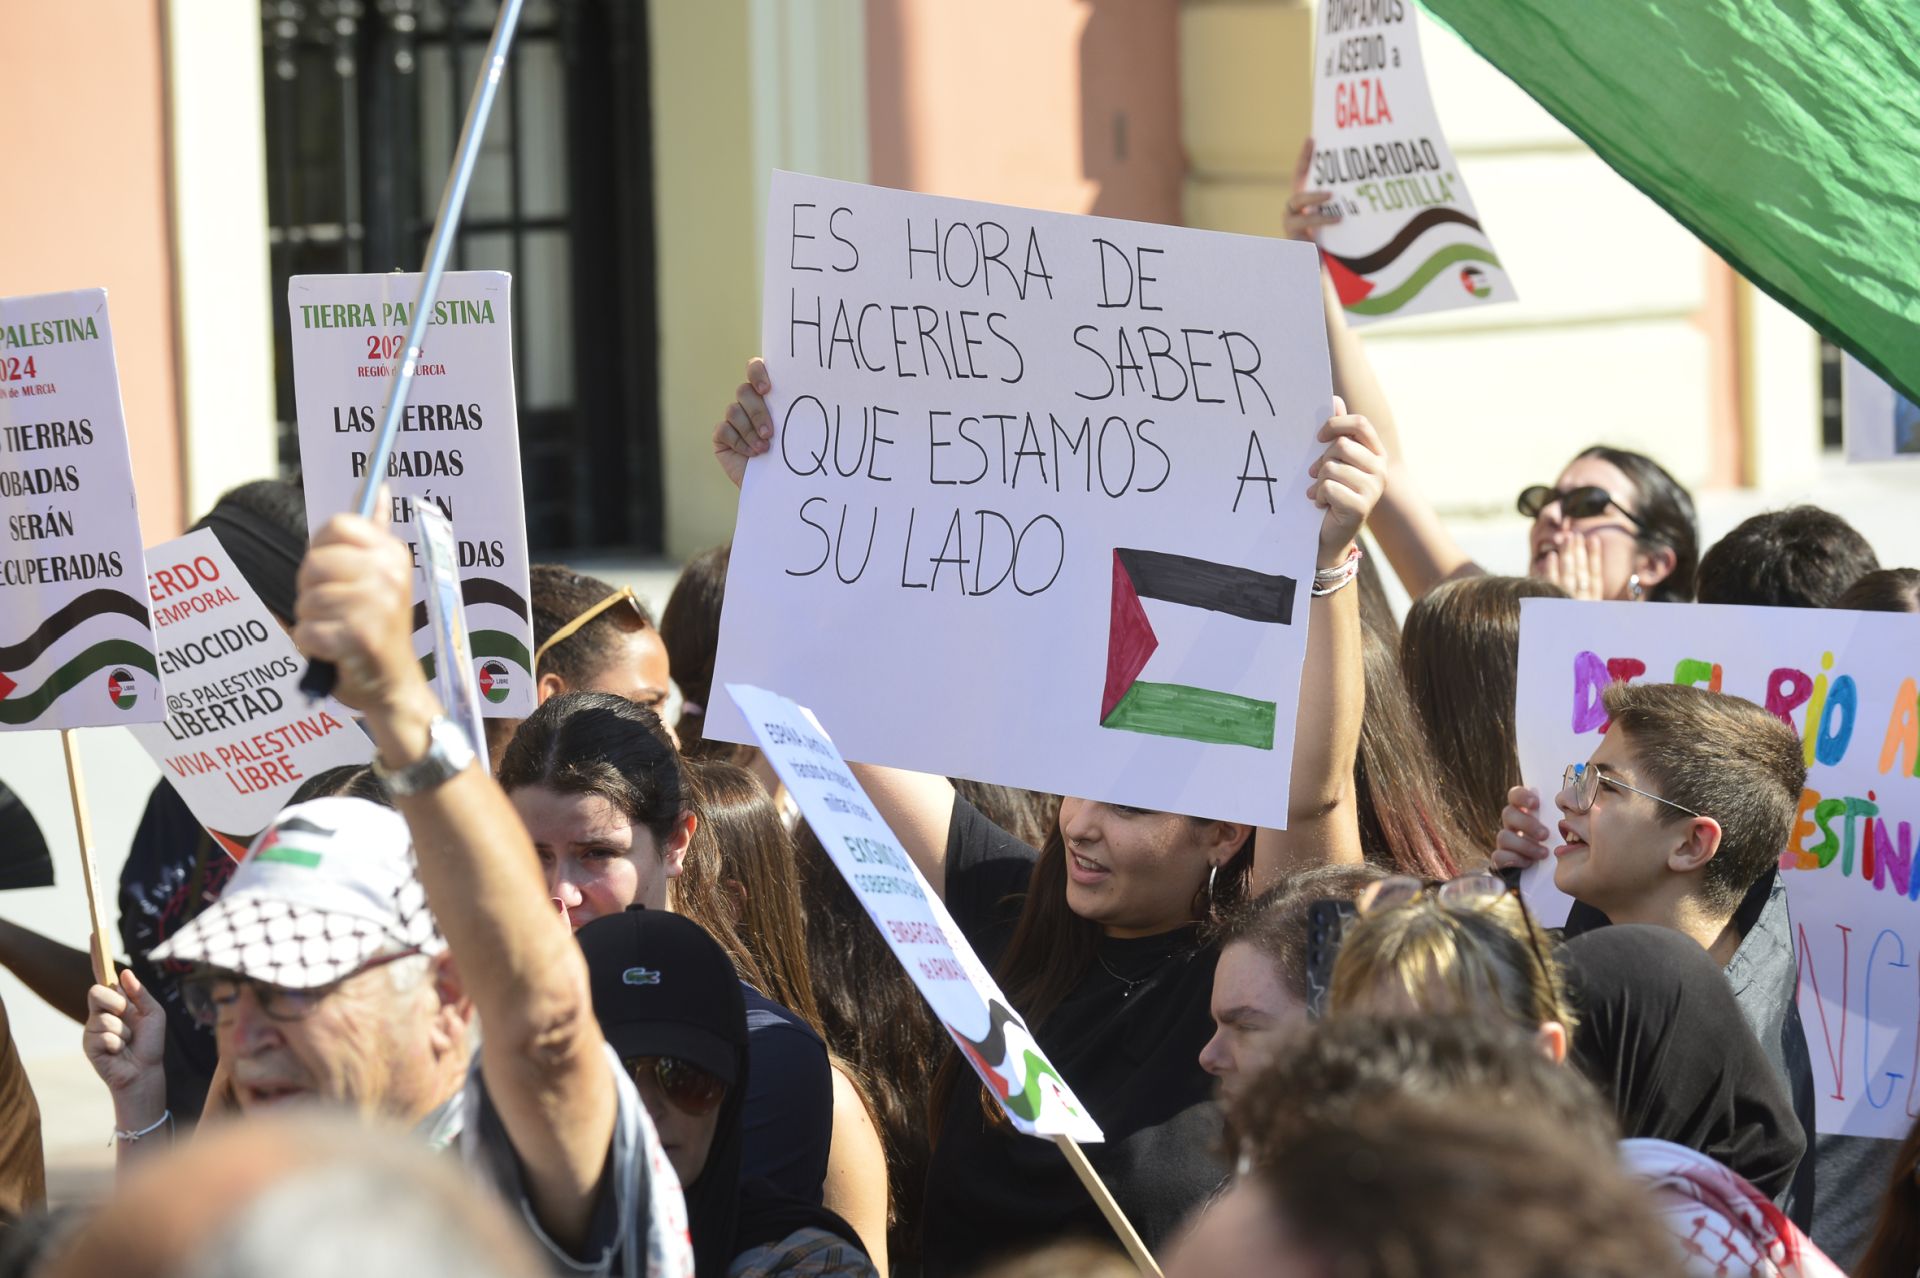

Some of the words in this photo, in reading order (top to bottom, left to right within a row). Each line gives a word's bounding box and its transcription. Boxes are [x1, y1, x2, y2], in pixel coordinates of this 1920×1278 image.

[1335, 78, 1393, 128] GAZA
[1315, 138, 1440, 185] SOLIDARIDAD
[791, 203, 859, 272] ES
[907, 218, 1054, 301] HORA
[1092, 238, 1165, 312] DE
[300, 304, 376, 328] TIERRA
[367, 335, 424, 360] 202
[791, 287, 1024, 384] HACERLES
[1074, 324, 1276, 416] SABER
[22, 383, 57, 396] MURCIA
[413, 364, 446, 377] URCIA
[4, 419, 94, 452] TIERRAS
[333, 406, 376, 433] LAS
[382, 404, 483, 432] ERRAS
[351, 450, 464, 478] RBADAS
[781, 395, 899, 482] QUE
[929, 410, 1171, 499] ESTAMOS
[1232, 430, 1278, 514] A
[0, 465, 80, 498] OBADAS
[9, 505, 74, 541] SERÁN
[785, 497, 878, 584] SU
[901, 507, 1065, 597] LADO
[192, 656, 298, 705] PALESTINOS
[163, 687, 283, 741] LIBERTAD
[165, 751, 221, 778] VIVA
[215, 711, 343, 767] PALESTINA
[225, 755, 303, 795] LIBRE
